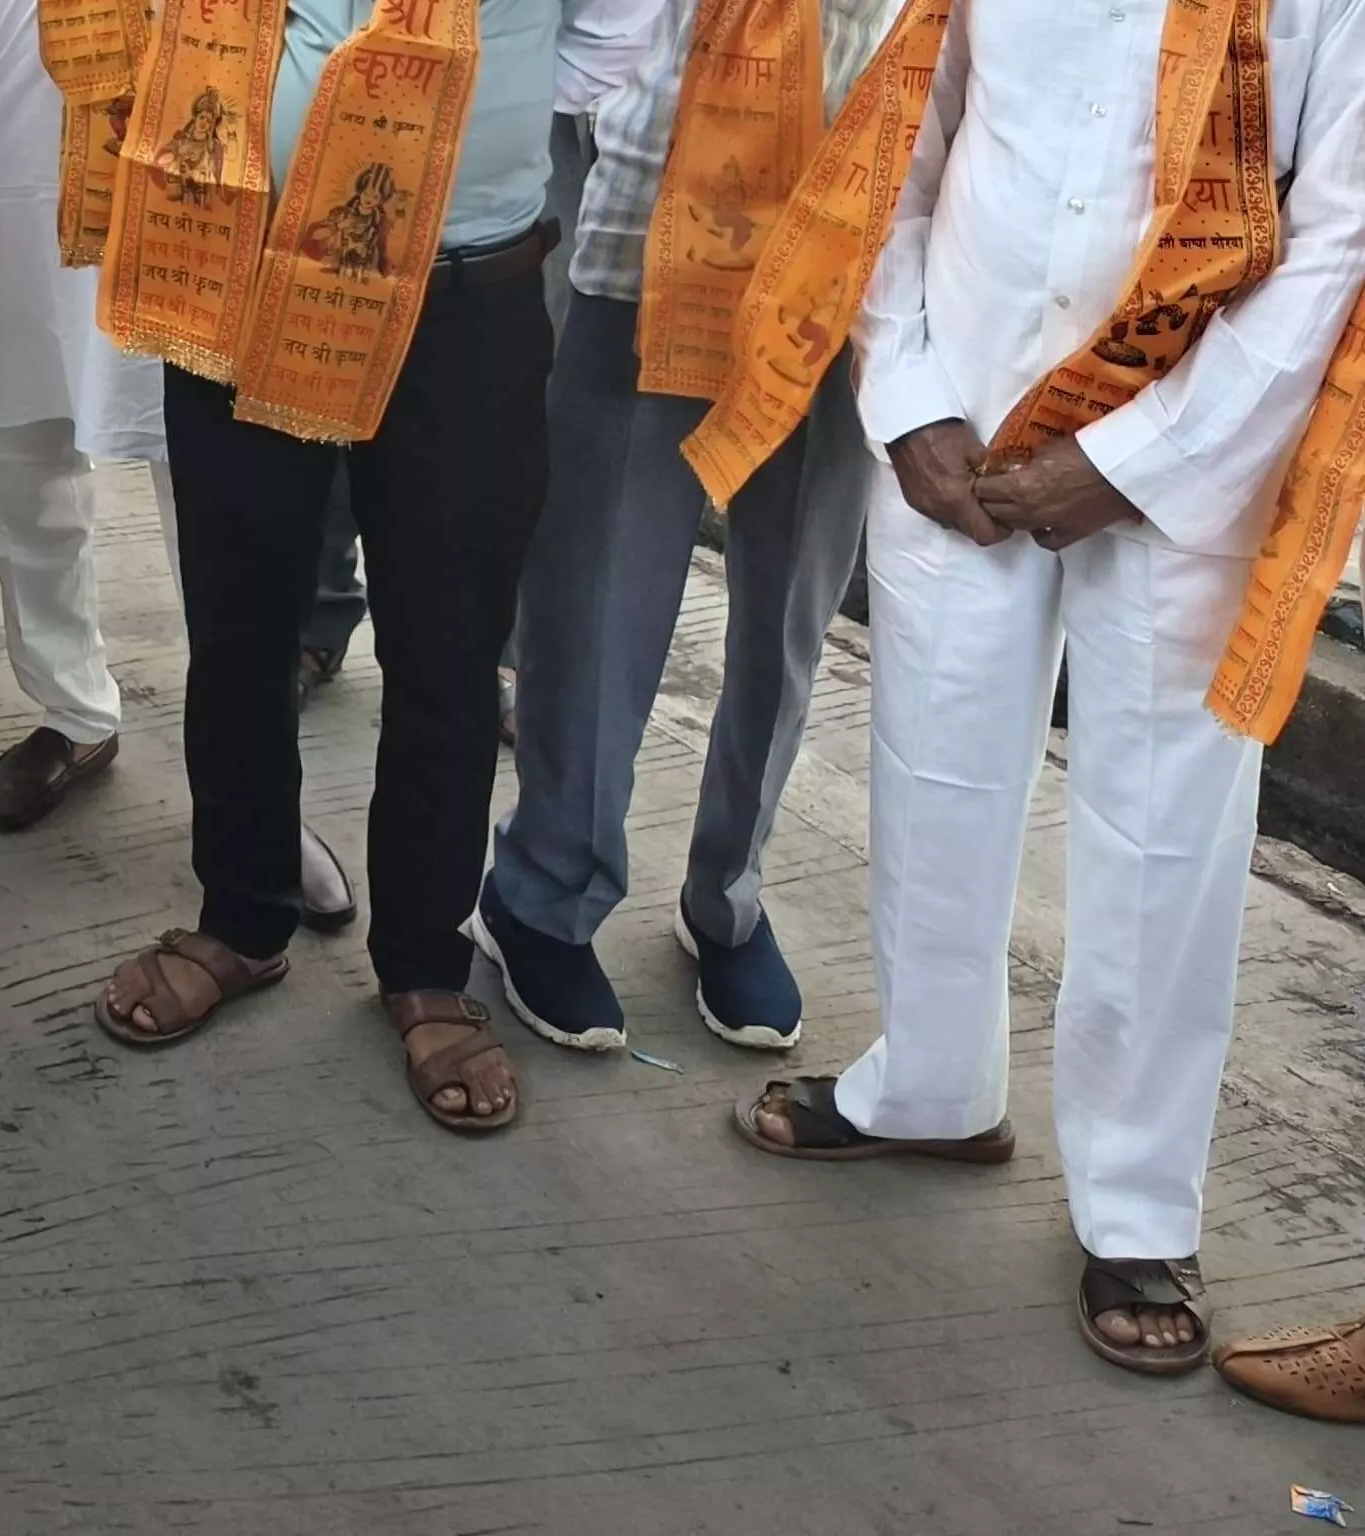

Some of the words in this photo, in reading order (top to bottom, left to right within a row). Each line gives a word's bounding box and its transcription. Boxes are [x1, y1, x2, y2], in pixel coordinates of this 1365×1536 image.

[352, 46, 444, 100] कृष्ण
[146, 210, 171, 229] जय
[174, 211, 193, 233] श्री
[294, 283, 322, 304] जय
[324, 286, 346, 309] श्री
